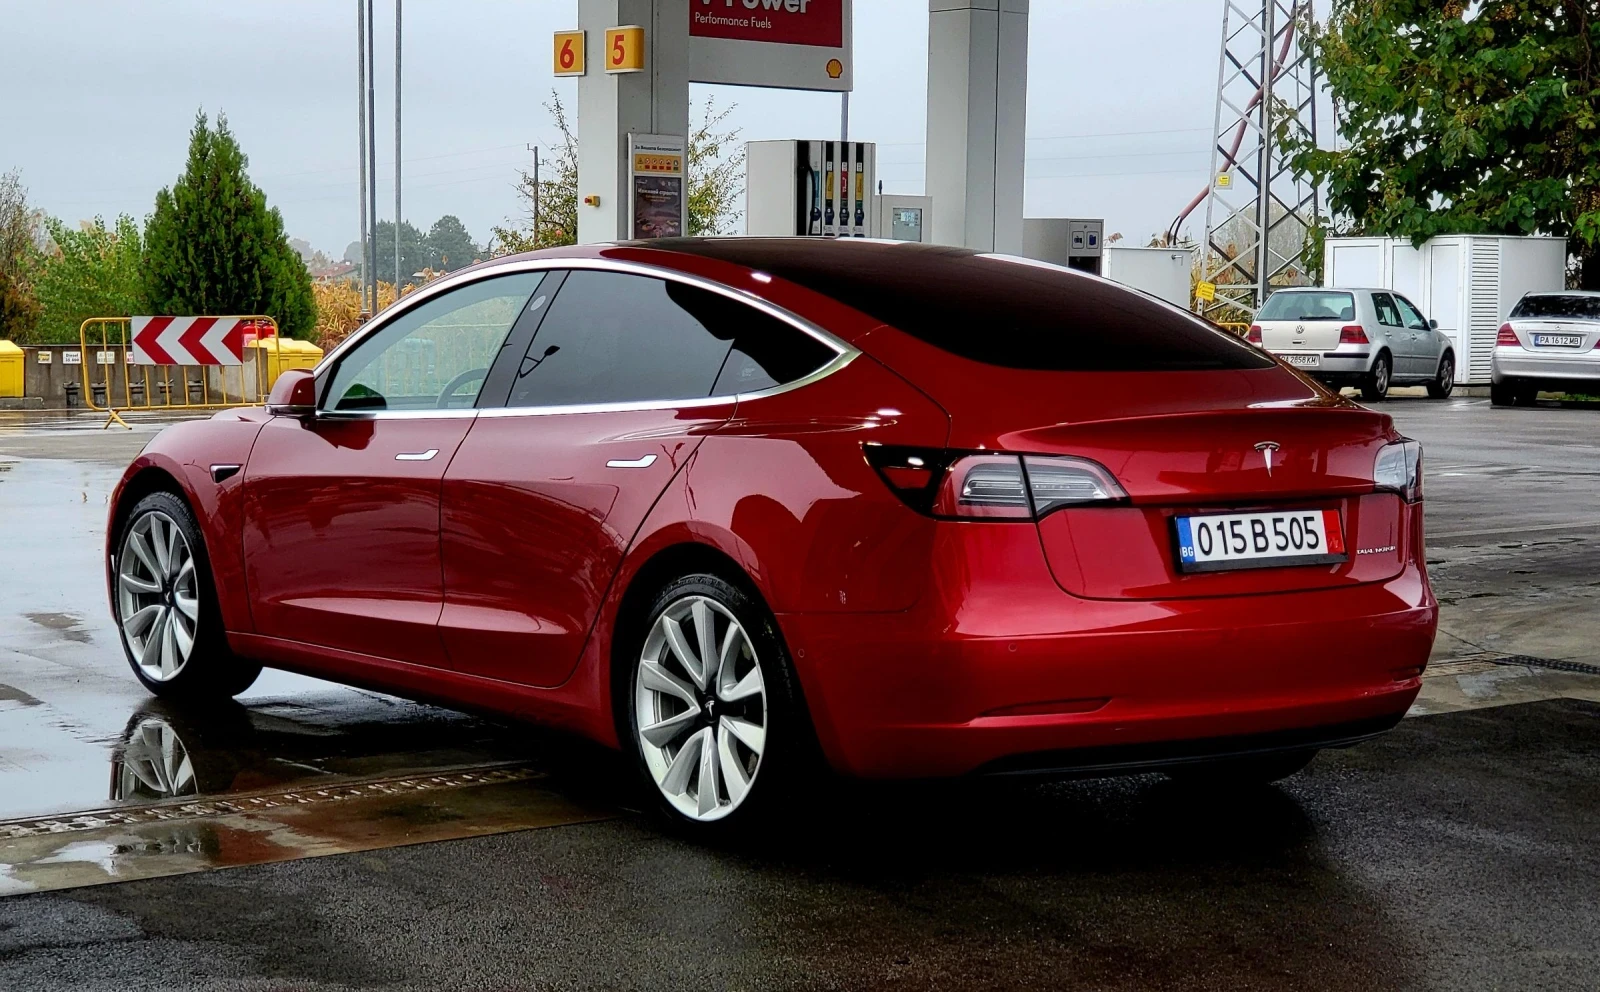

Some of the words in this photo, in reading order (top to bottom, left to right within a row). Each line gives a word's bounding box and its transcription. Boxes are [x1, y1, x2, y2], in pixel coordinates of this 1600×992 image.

[695, 12, 749, 27] Performance
[751, 16, 772, 29] Fuels
[559, 39, 575, 69] 6
[612, 34, 626, 65] 5
[1182, 547, 1194, 557] BG
